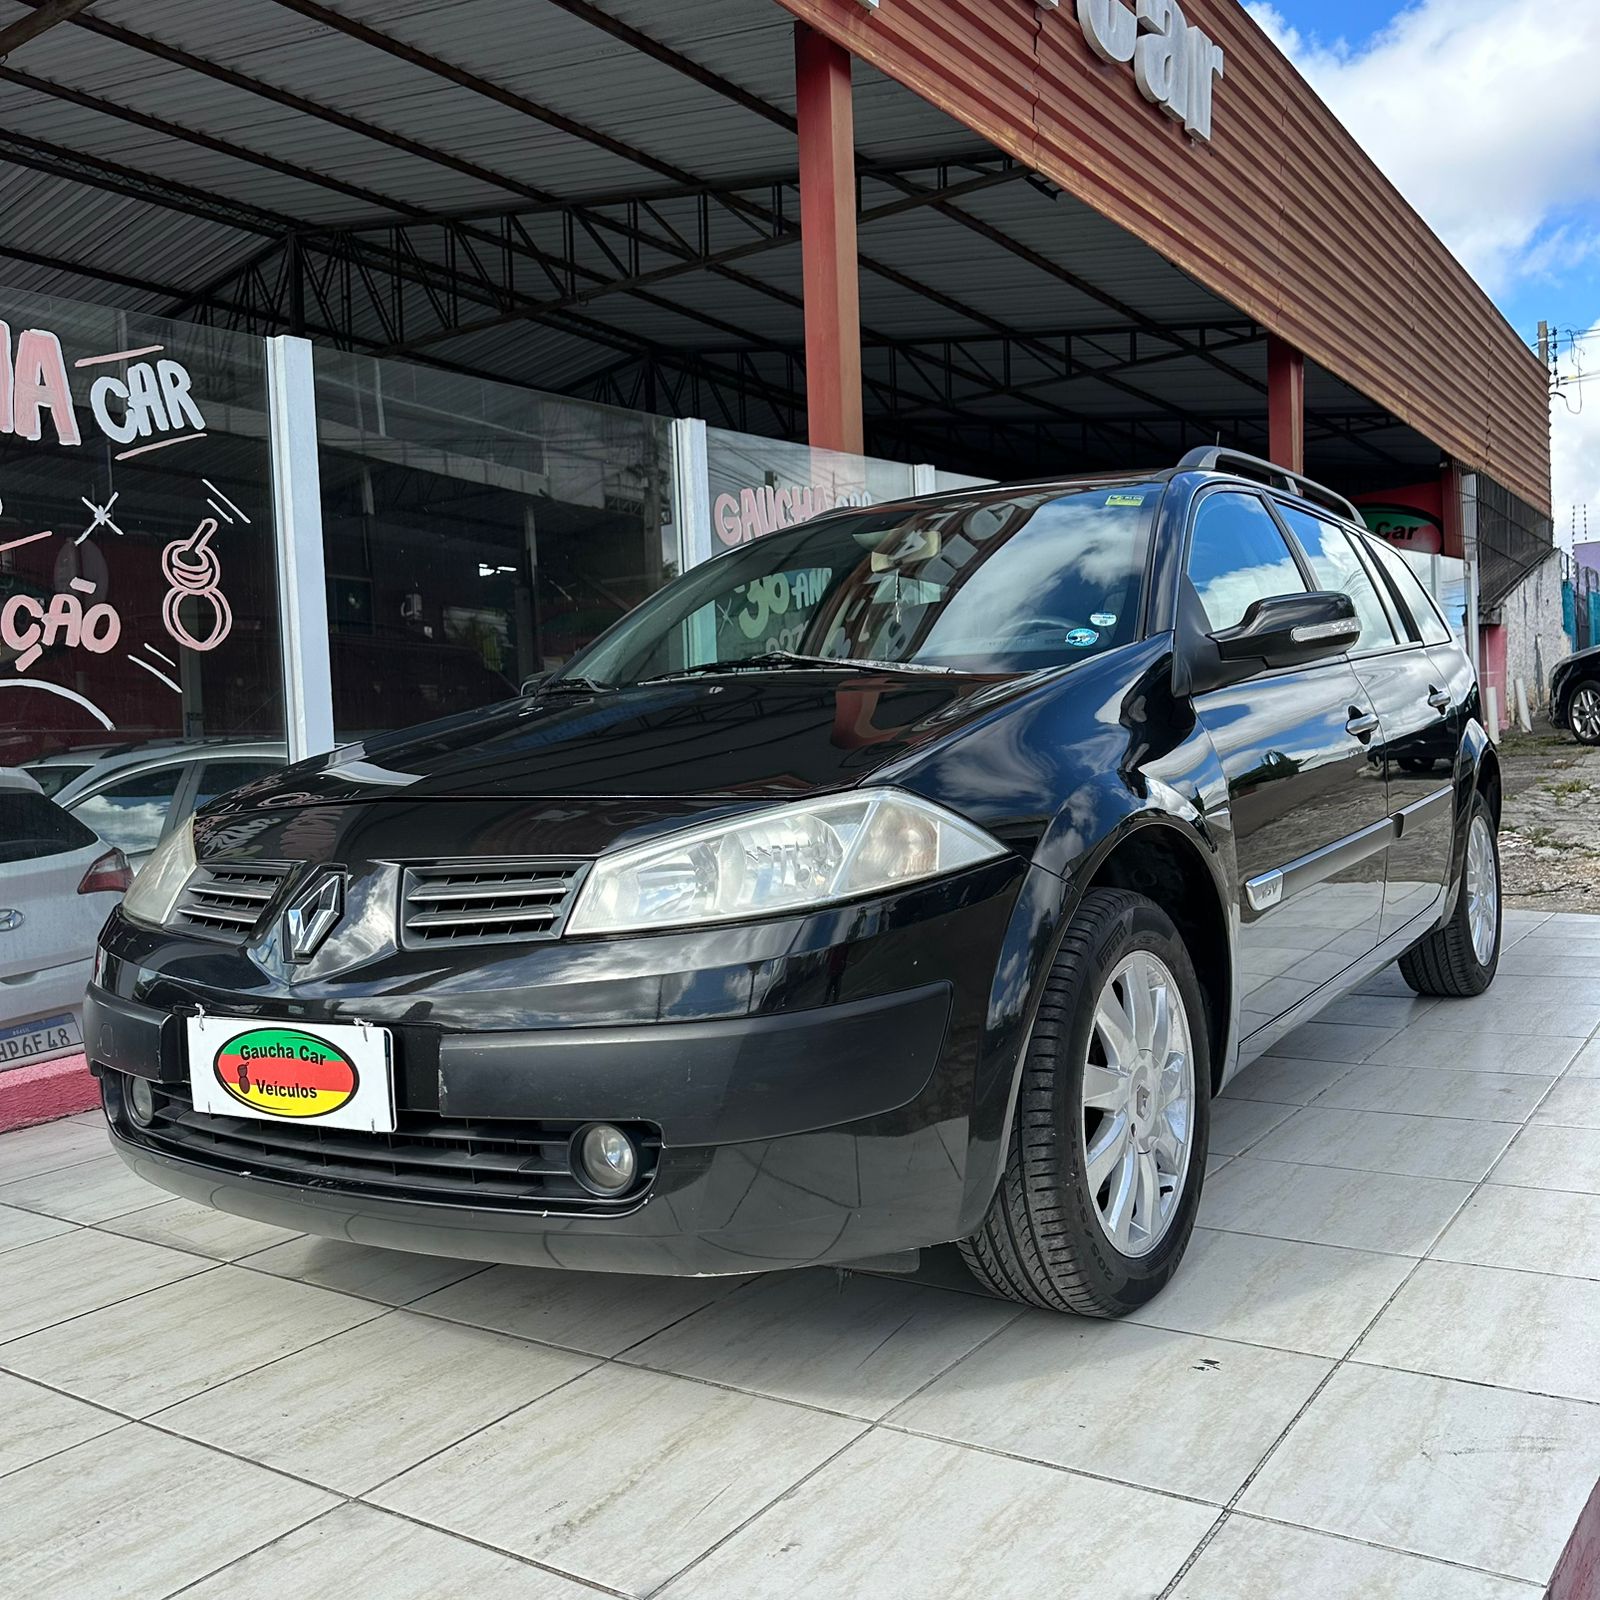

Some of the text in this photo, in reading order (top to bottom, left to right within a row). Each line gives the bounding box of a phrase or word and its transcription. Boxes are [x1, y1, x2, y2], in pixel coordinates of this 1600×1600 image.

[90, 359, 206, 444] CAR
[714, 484, 829, 546] GAUCHA
[1375, 521, 1419, 541] Car
[240, 1042, 327, 1066] Gaucha Car
[255, 1078, 318, 1099] Veículos
